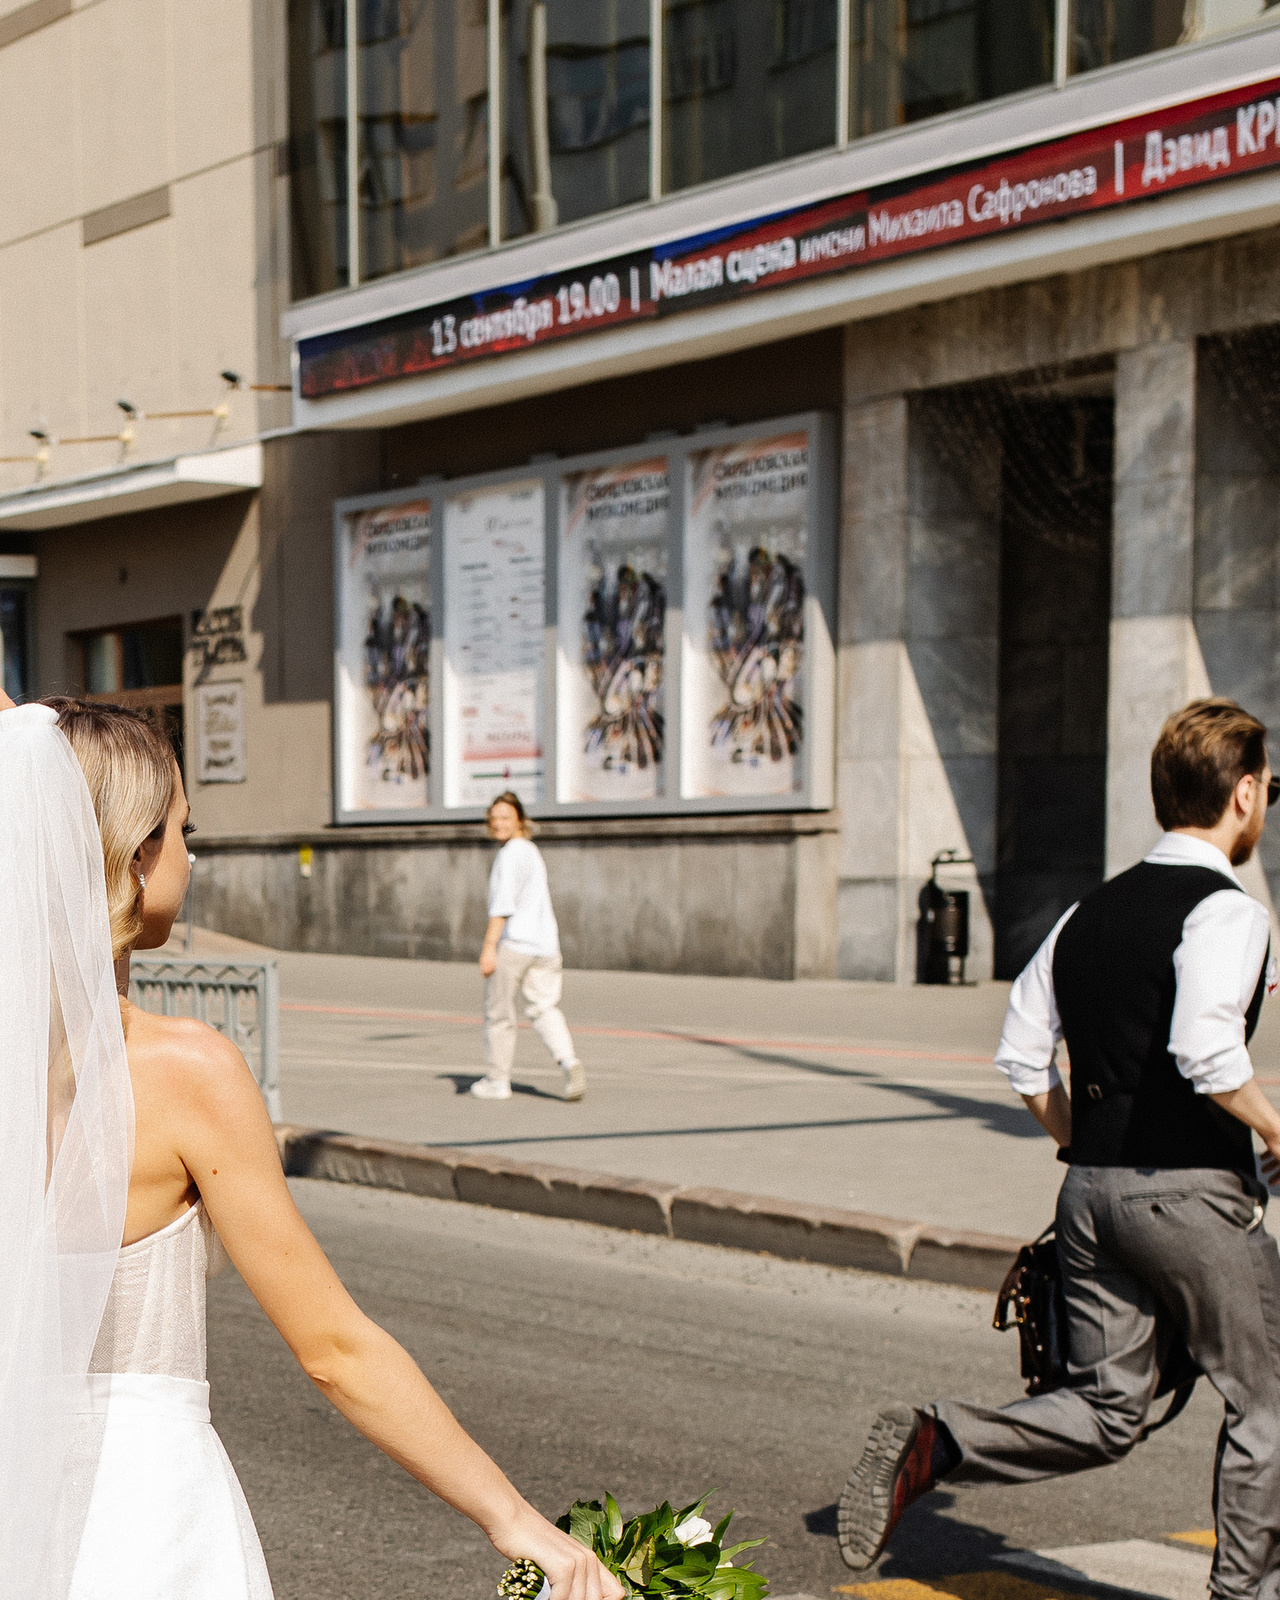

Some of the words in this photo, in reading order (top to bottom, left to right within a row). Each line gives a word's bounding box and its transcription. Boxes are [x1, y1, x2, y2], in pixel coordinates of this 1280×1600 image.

[430, 313, 458, 357] 13
[459, 297, 554, 342] сентября
[556, 272, 621, 326] 19.00
[649, 254, 724, 301] Малая
[725, 236, 798, 285] сцена
[799, 224, 867, 265] имени
[868, 199, 965, 248] Михаила
[966, 165, 1099, 226] Сафронова
[1141, 126, 1232, 188] Дэвид
